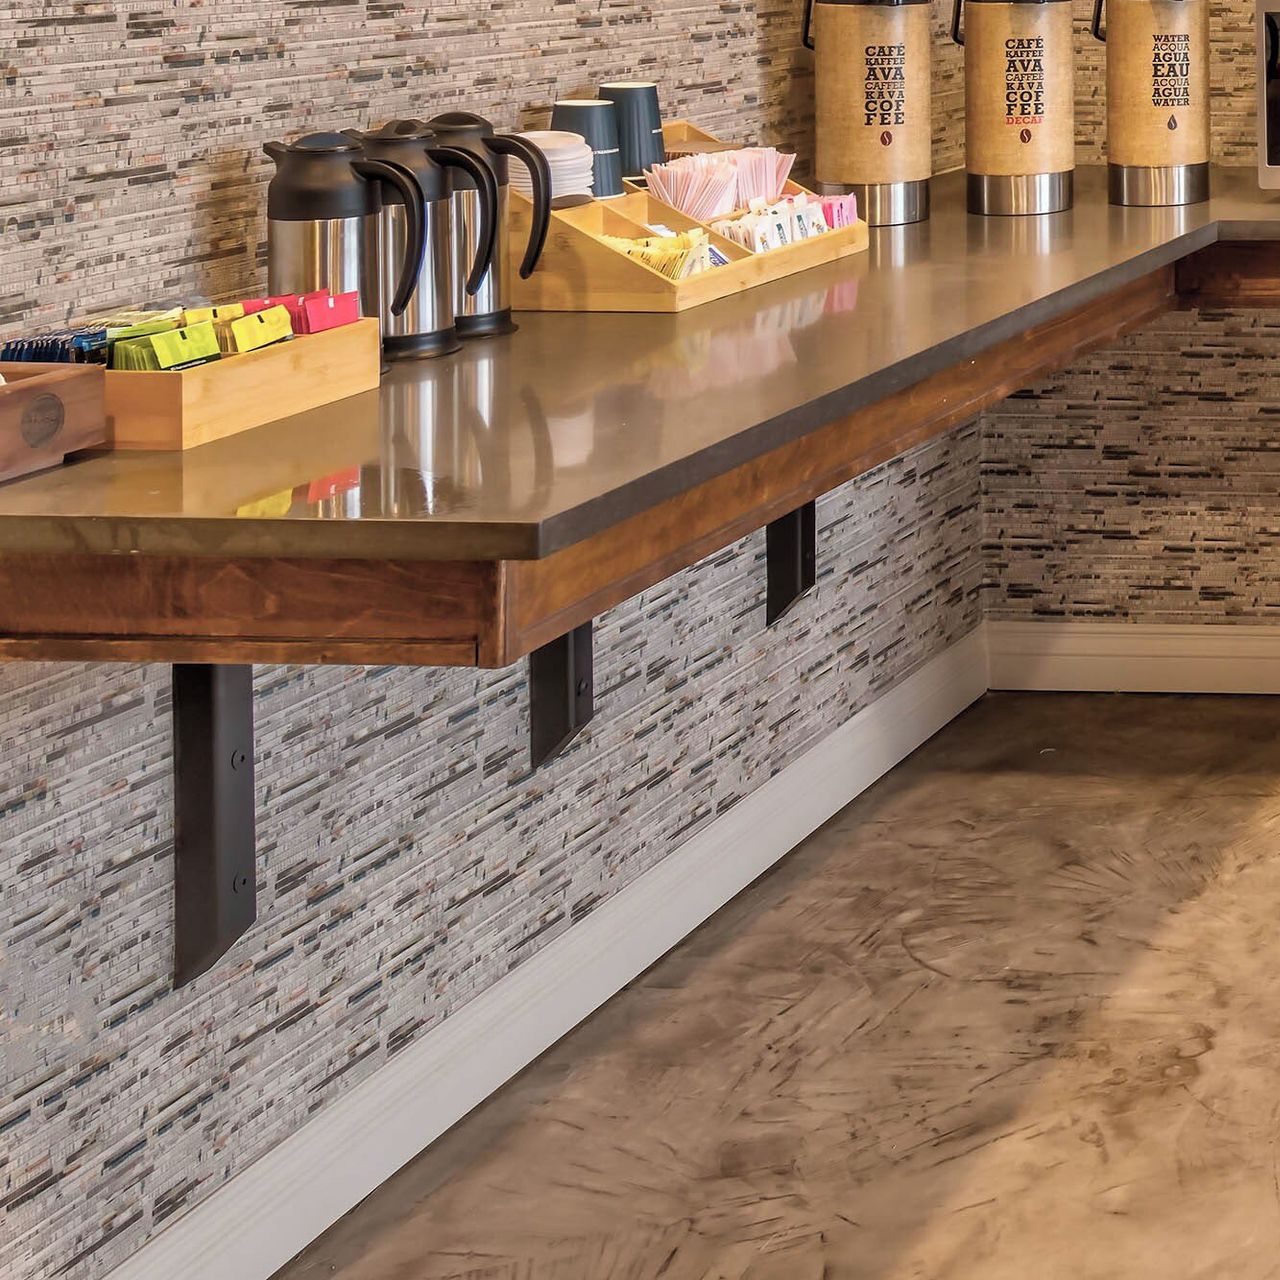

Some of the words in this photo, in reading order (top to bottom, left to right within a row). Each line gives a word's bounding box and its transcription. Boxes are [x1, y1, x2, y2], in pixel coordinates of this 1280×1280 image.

[1005, 36, 1043, 49] CAFÉ
[1152, 43, 1190, 51] ACQUA
[865, 43, 905, 56] CAFÉ
[1006, 50, 1043, 58] KAFFEE
[1152, 52, 1190, 62] AGUA
[1152, 63, 1190, 77] EAU
[1006, 73, 1044, 81] CAFFEE
[865, 81, 905, 90] CAFFEE
[1152, 78, 1190, 87] ACQUA
[1006, 91, 1044, 102] COF
[1152, 87, 1190, 97] AGUA
[865, 100, 905, 112] COF
[1152, 98, 1190, 106] WATER
[1006, 103, 1044, 115] FEE
[864, 112, 905, 125] FEE
[1006, 116, 1044, 125] DECAF
